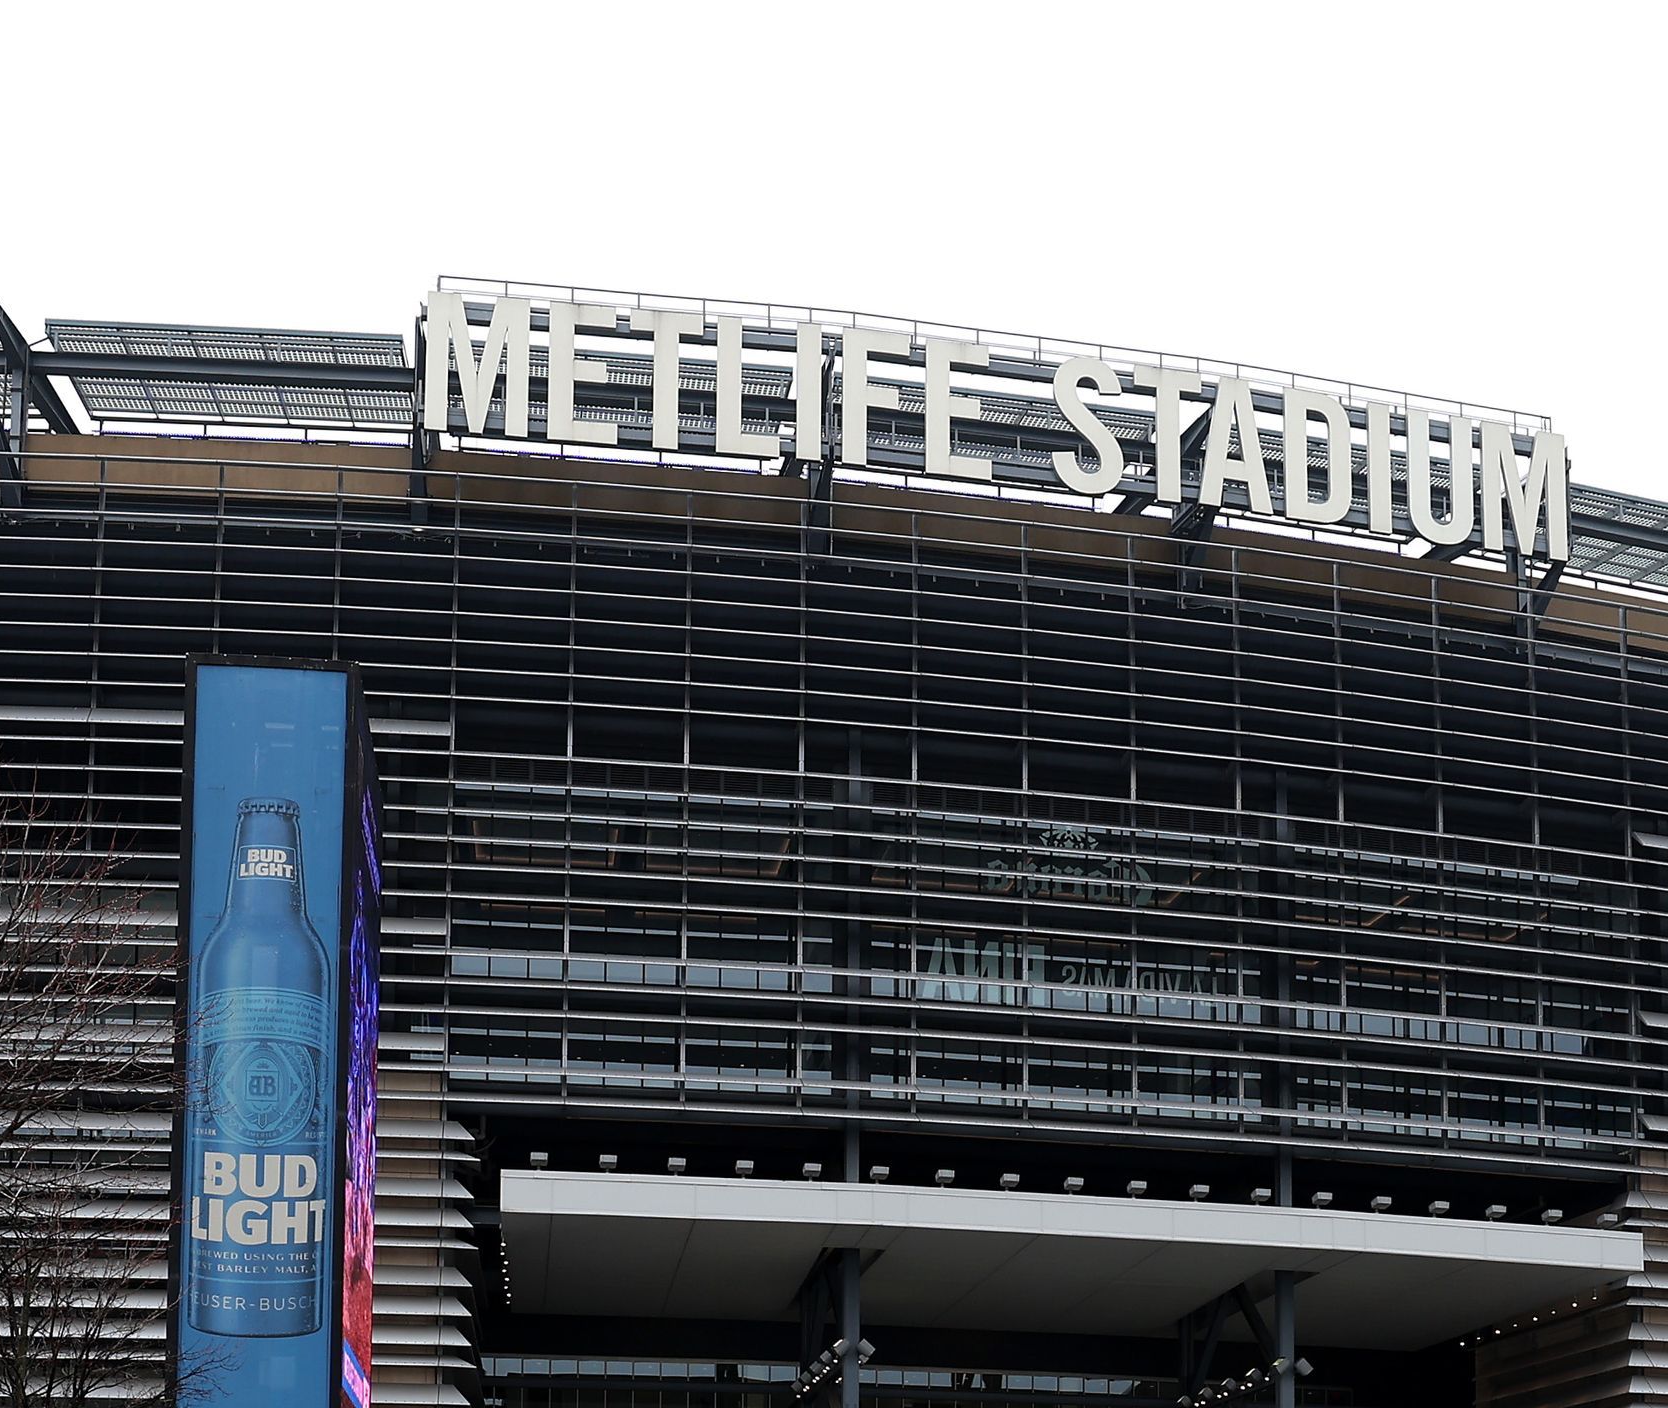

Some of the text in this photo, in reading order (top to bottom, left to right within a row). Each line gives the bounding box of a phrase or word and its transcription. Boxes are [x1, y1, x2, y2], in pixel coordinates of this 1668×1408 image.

[422, 290, 1569, 561] METLIFE STADIUM
[247, 848, 287, 863] BUD
[239, 862, 294, 879] LIGHT
[203, 1151, 318, 1198] BUD
[191, 1195, 326, 1246] LIGHT
[243, 1252, 285, 1262] USING
[288, 1252, 310, 1261] THE
[217, 1263, 269, 1273] BARLEY
